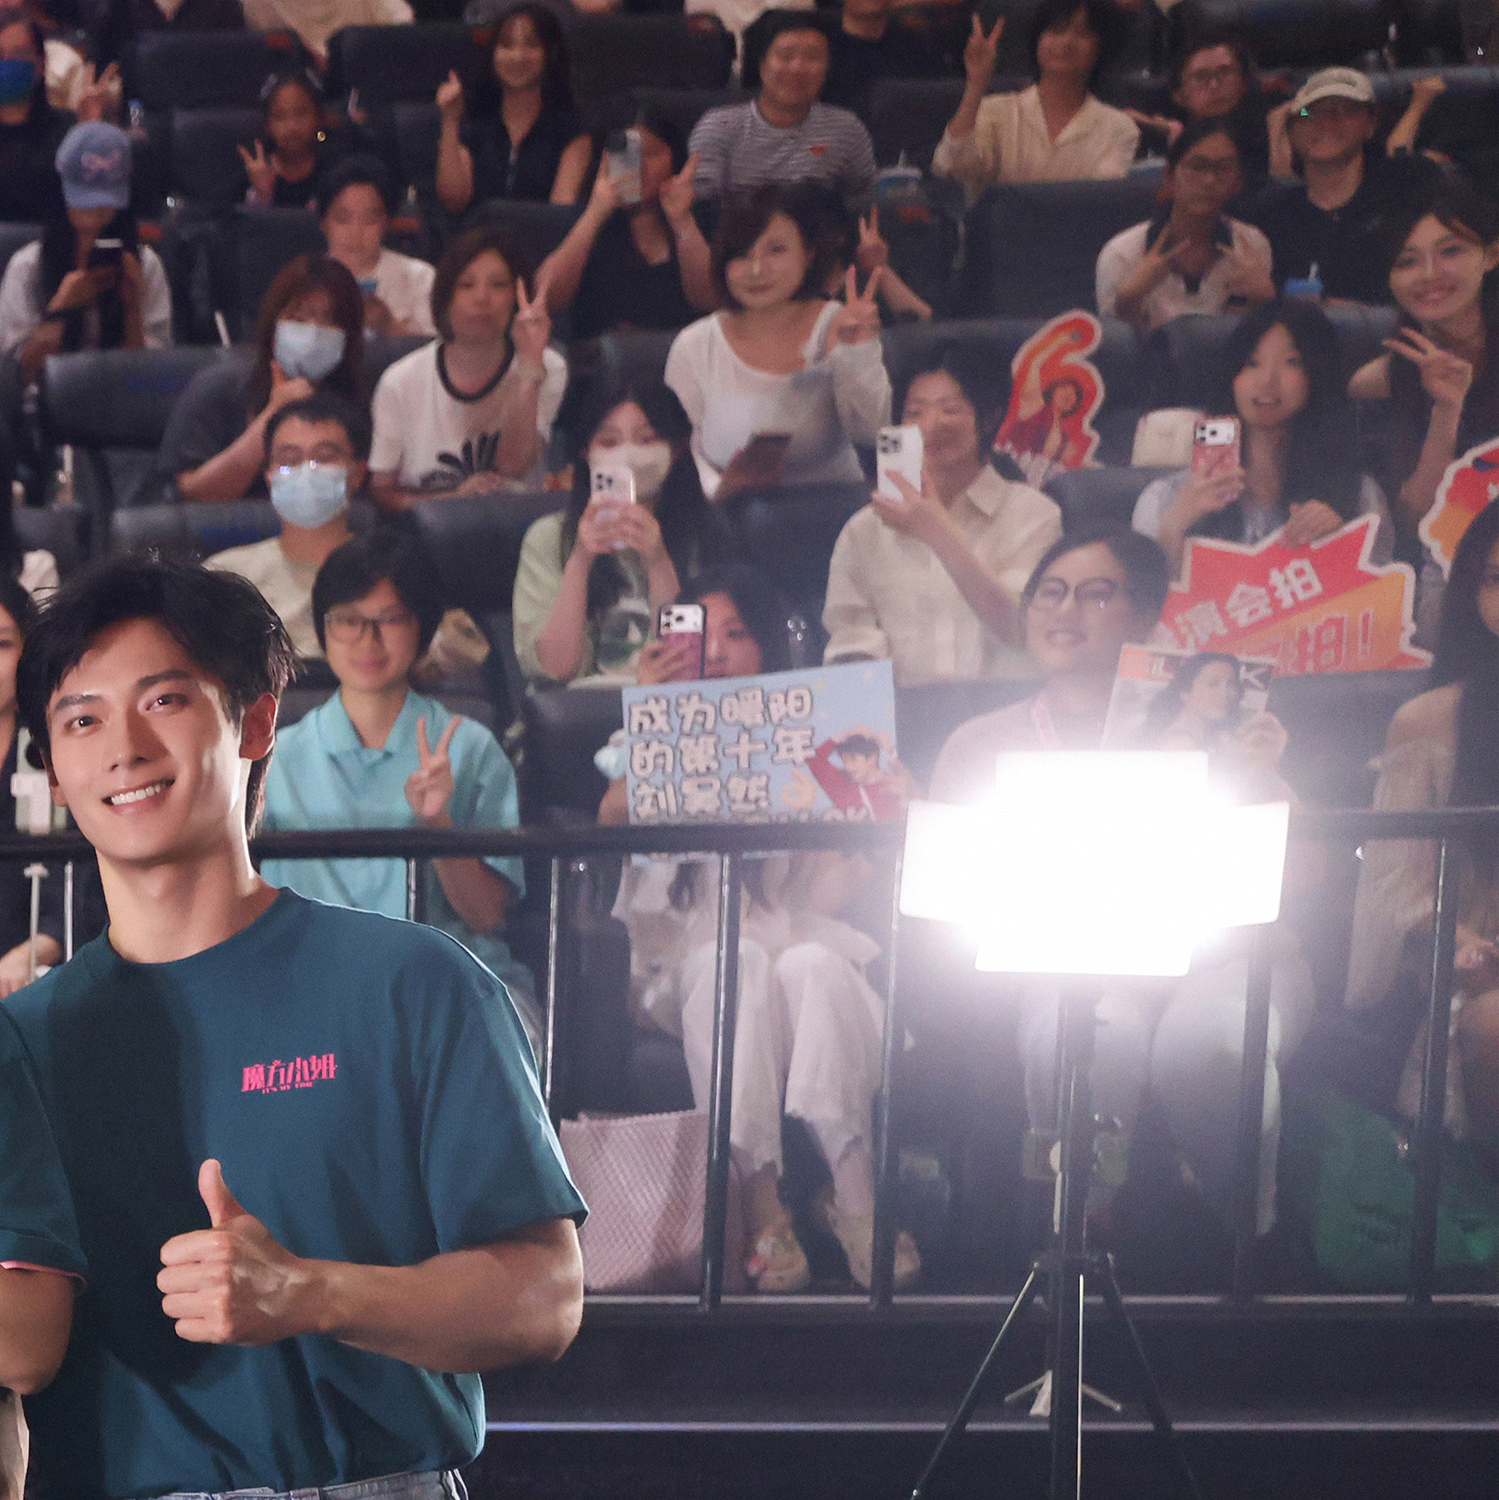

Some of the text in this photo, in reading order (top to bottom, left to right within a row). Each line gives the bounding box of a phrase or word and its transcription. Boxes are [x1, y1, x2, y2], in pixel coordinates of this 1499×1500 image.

[629, 684, 814, 737] 成为暖阳
[630, 725, 817, 779] 的第十年
[241, 1053, 338, 1093] 魔方小姐
